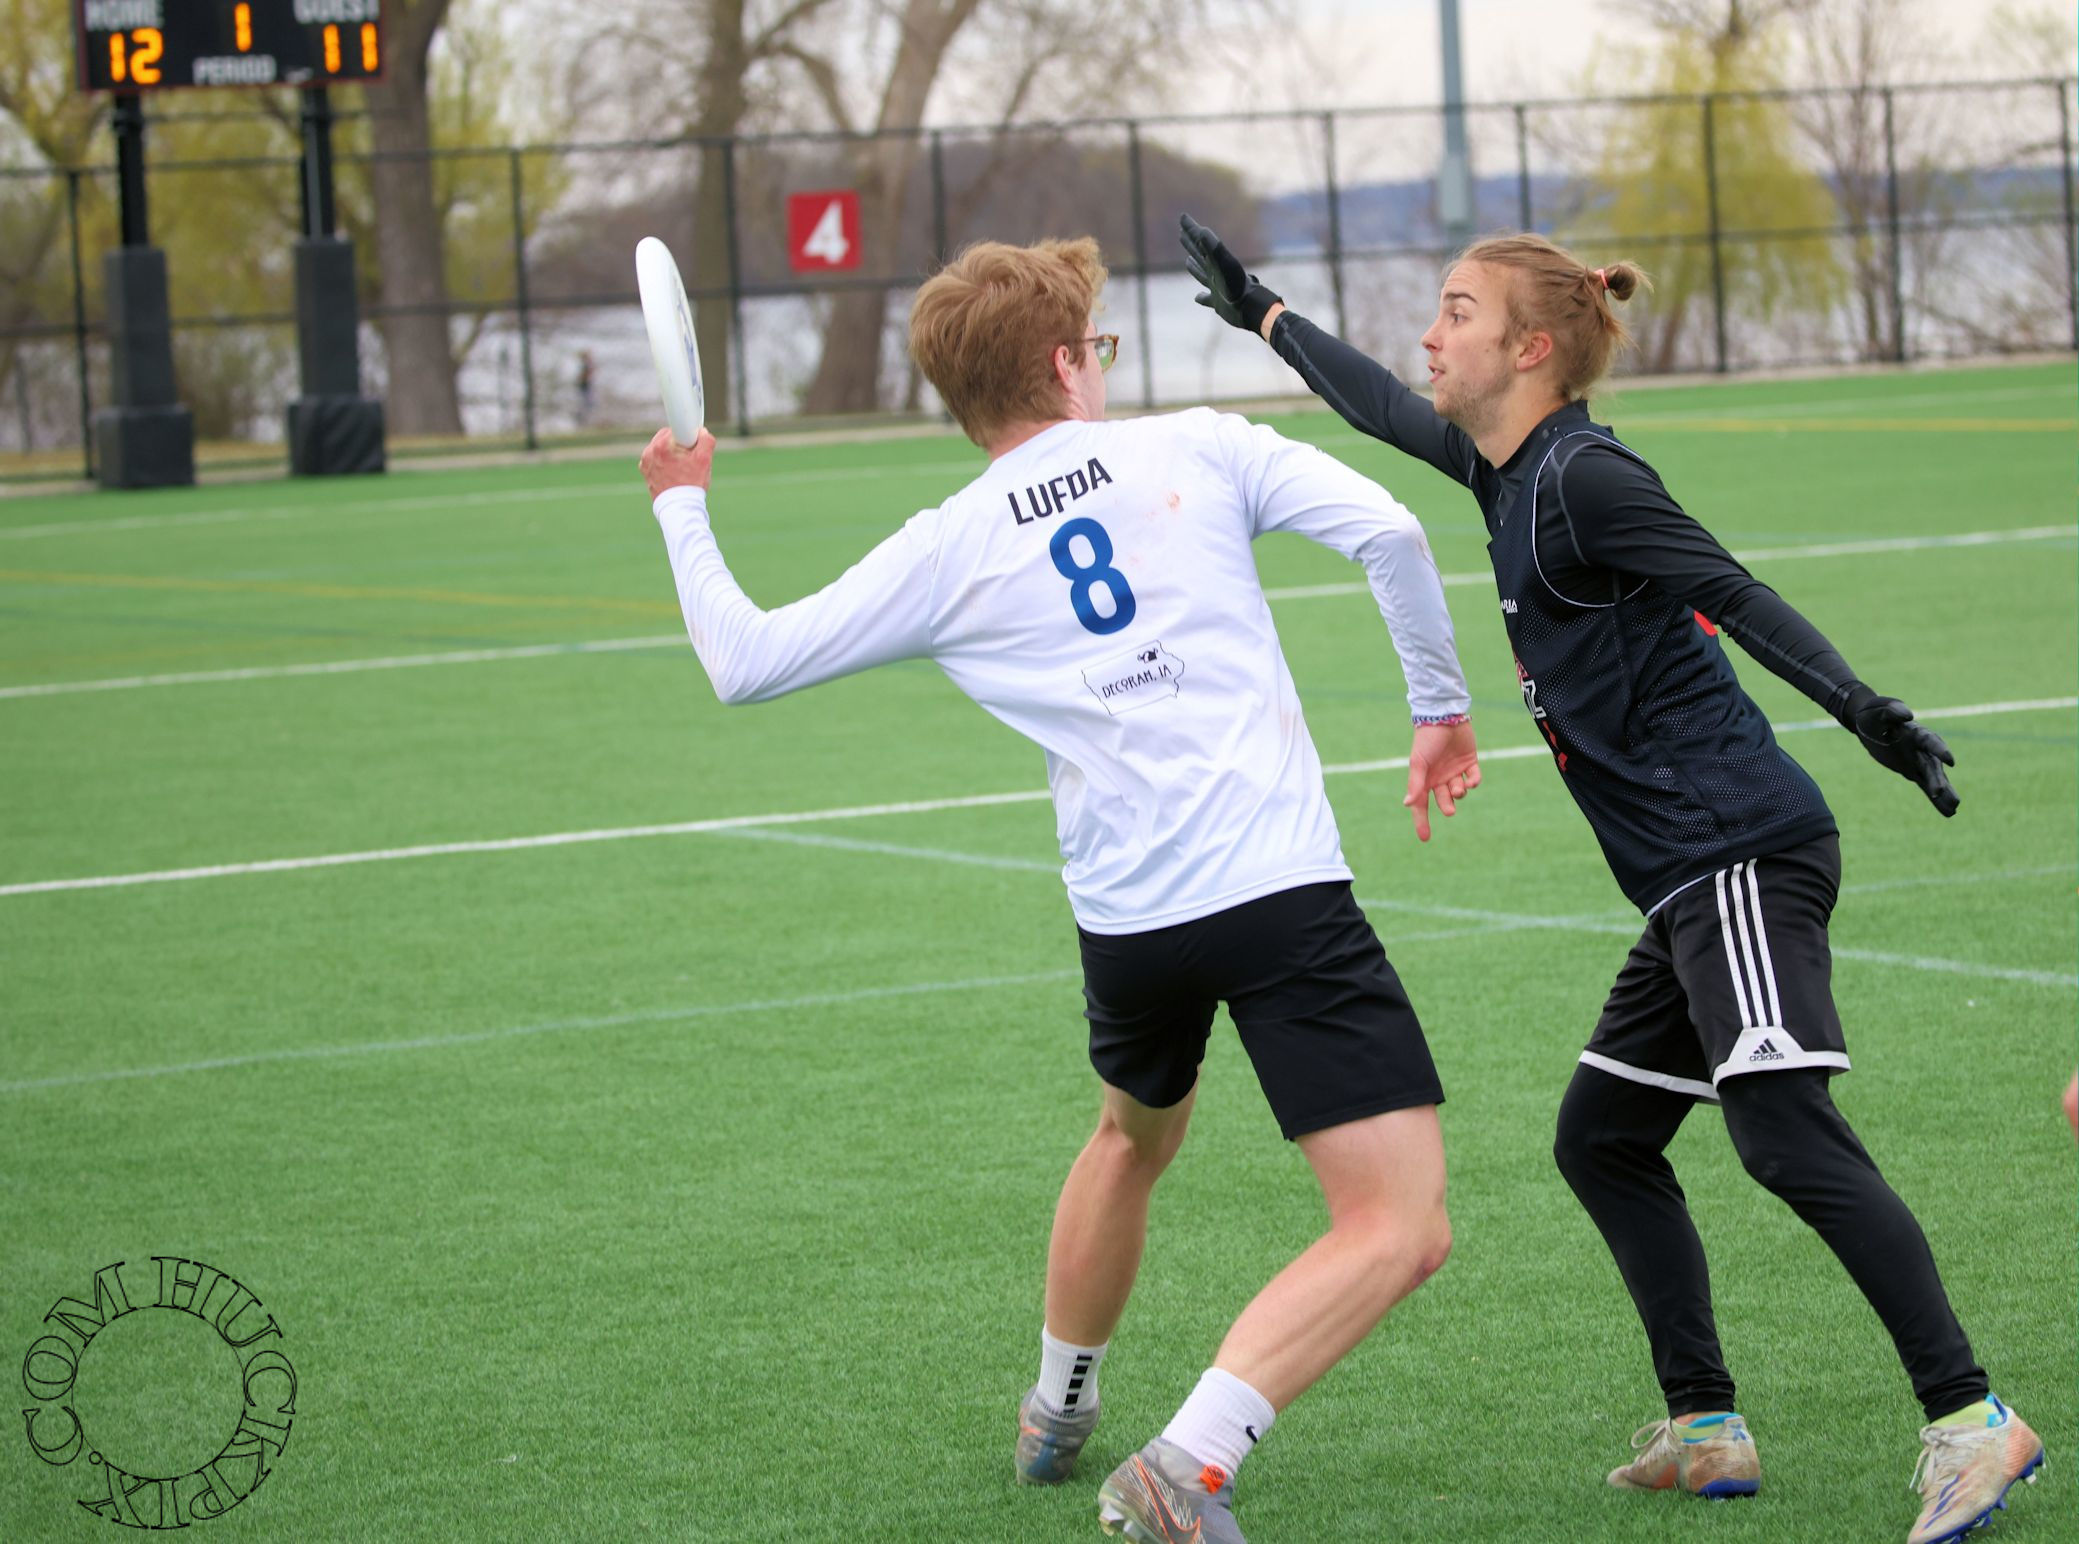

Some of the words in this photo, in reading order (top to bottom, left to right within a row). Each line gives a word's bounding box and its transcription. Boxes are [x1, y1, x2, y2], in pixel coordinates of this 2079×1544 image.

[235, 2, 252, 52] 1
[323, 22, 378, 73] 11
[109, 27, 163, 84] 12
[192, 55, 276, 85] PERIOD
[803, 199, 850, 264] 4
[1007, 457, 1113, 526] LUFDA
[1049, 517, 1137, 635] 8
[1158, 664, 1172, 678] IA
[1749, 1052, 1785, 1061] adidas
